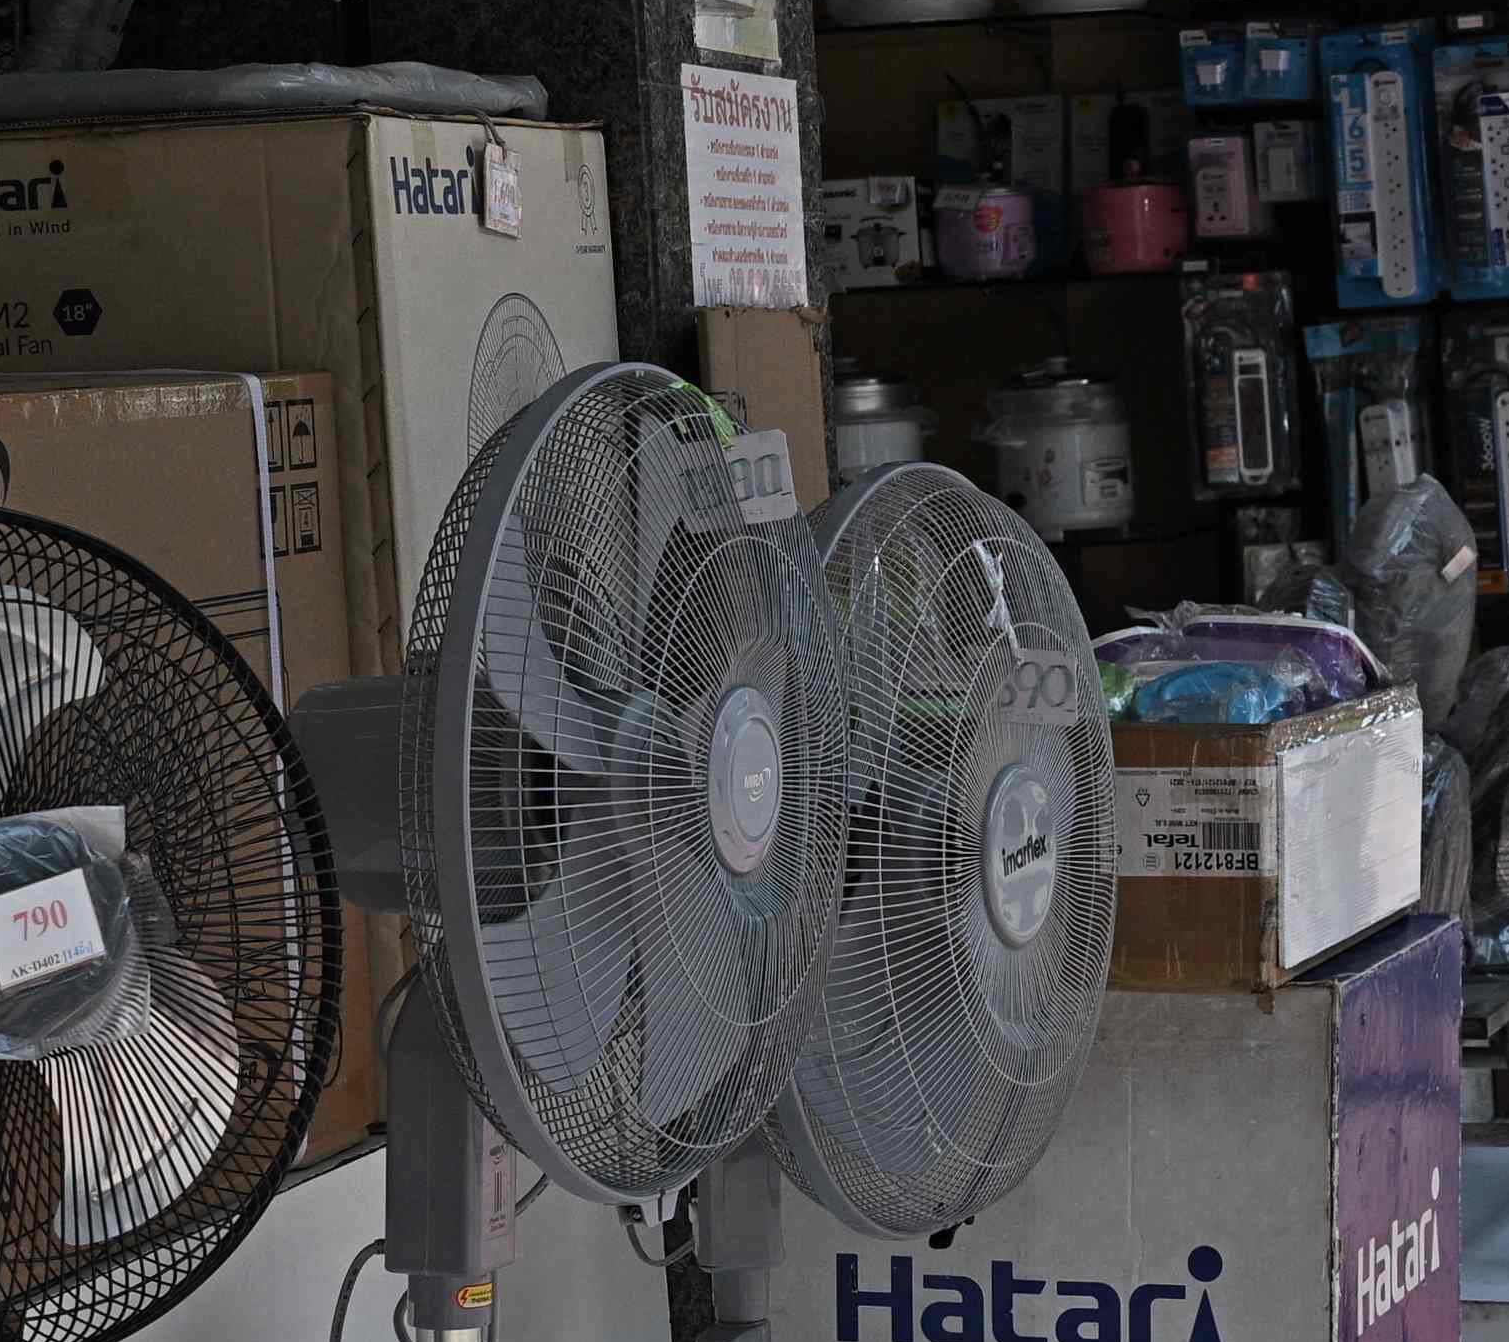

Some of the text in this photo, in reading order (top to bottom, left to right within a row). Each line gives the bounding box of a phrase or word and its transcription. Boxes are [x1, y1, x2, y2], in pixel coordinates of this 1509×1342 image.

[689, 79, 794, 137] รับสมัครงาน
[392, 144, 485, 217] Hatari
[29, 218, 74, 237] Wind
[15, 334, 53, 358] Fan
[1000, 820, 1049, 878] imarflex
[1144, 833, 1200, 849] Tefal
[1174, 851, 1260, 871] BF812121
[10, 897, 69, 942] 790
[1355, 1166, 1442, 1319] Hatari
